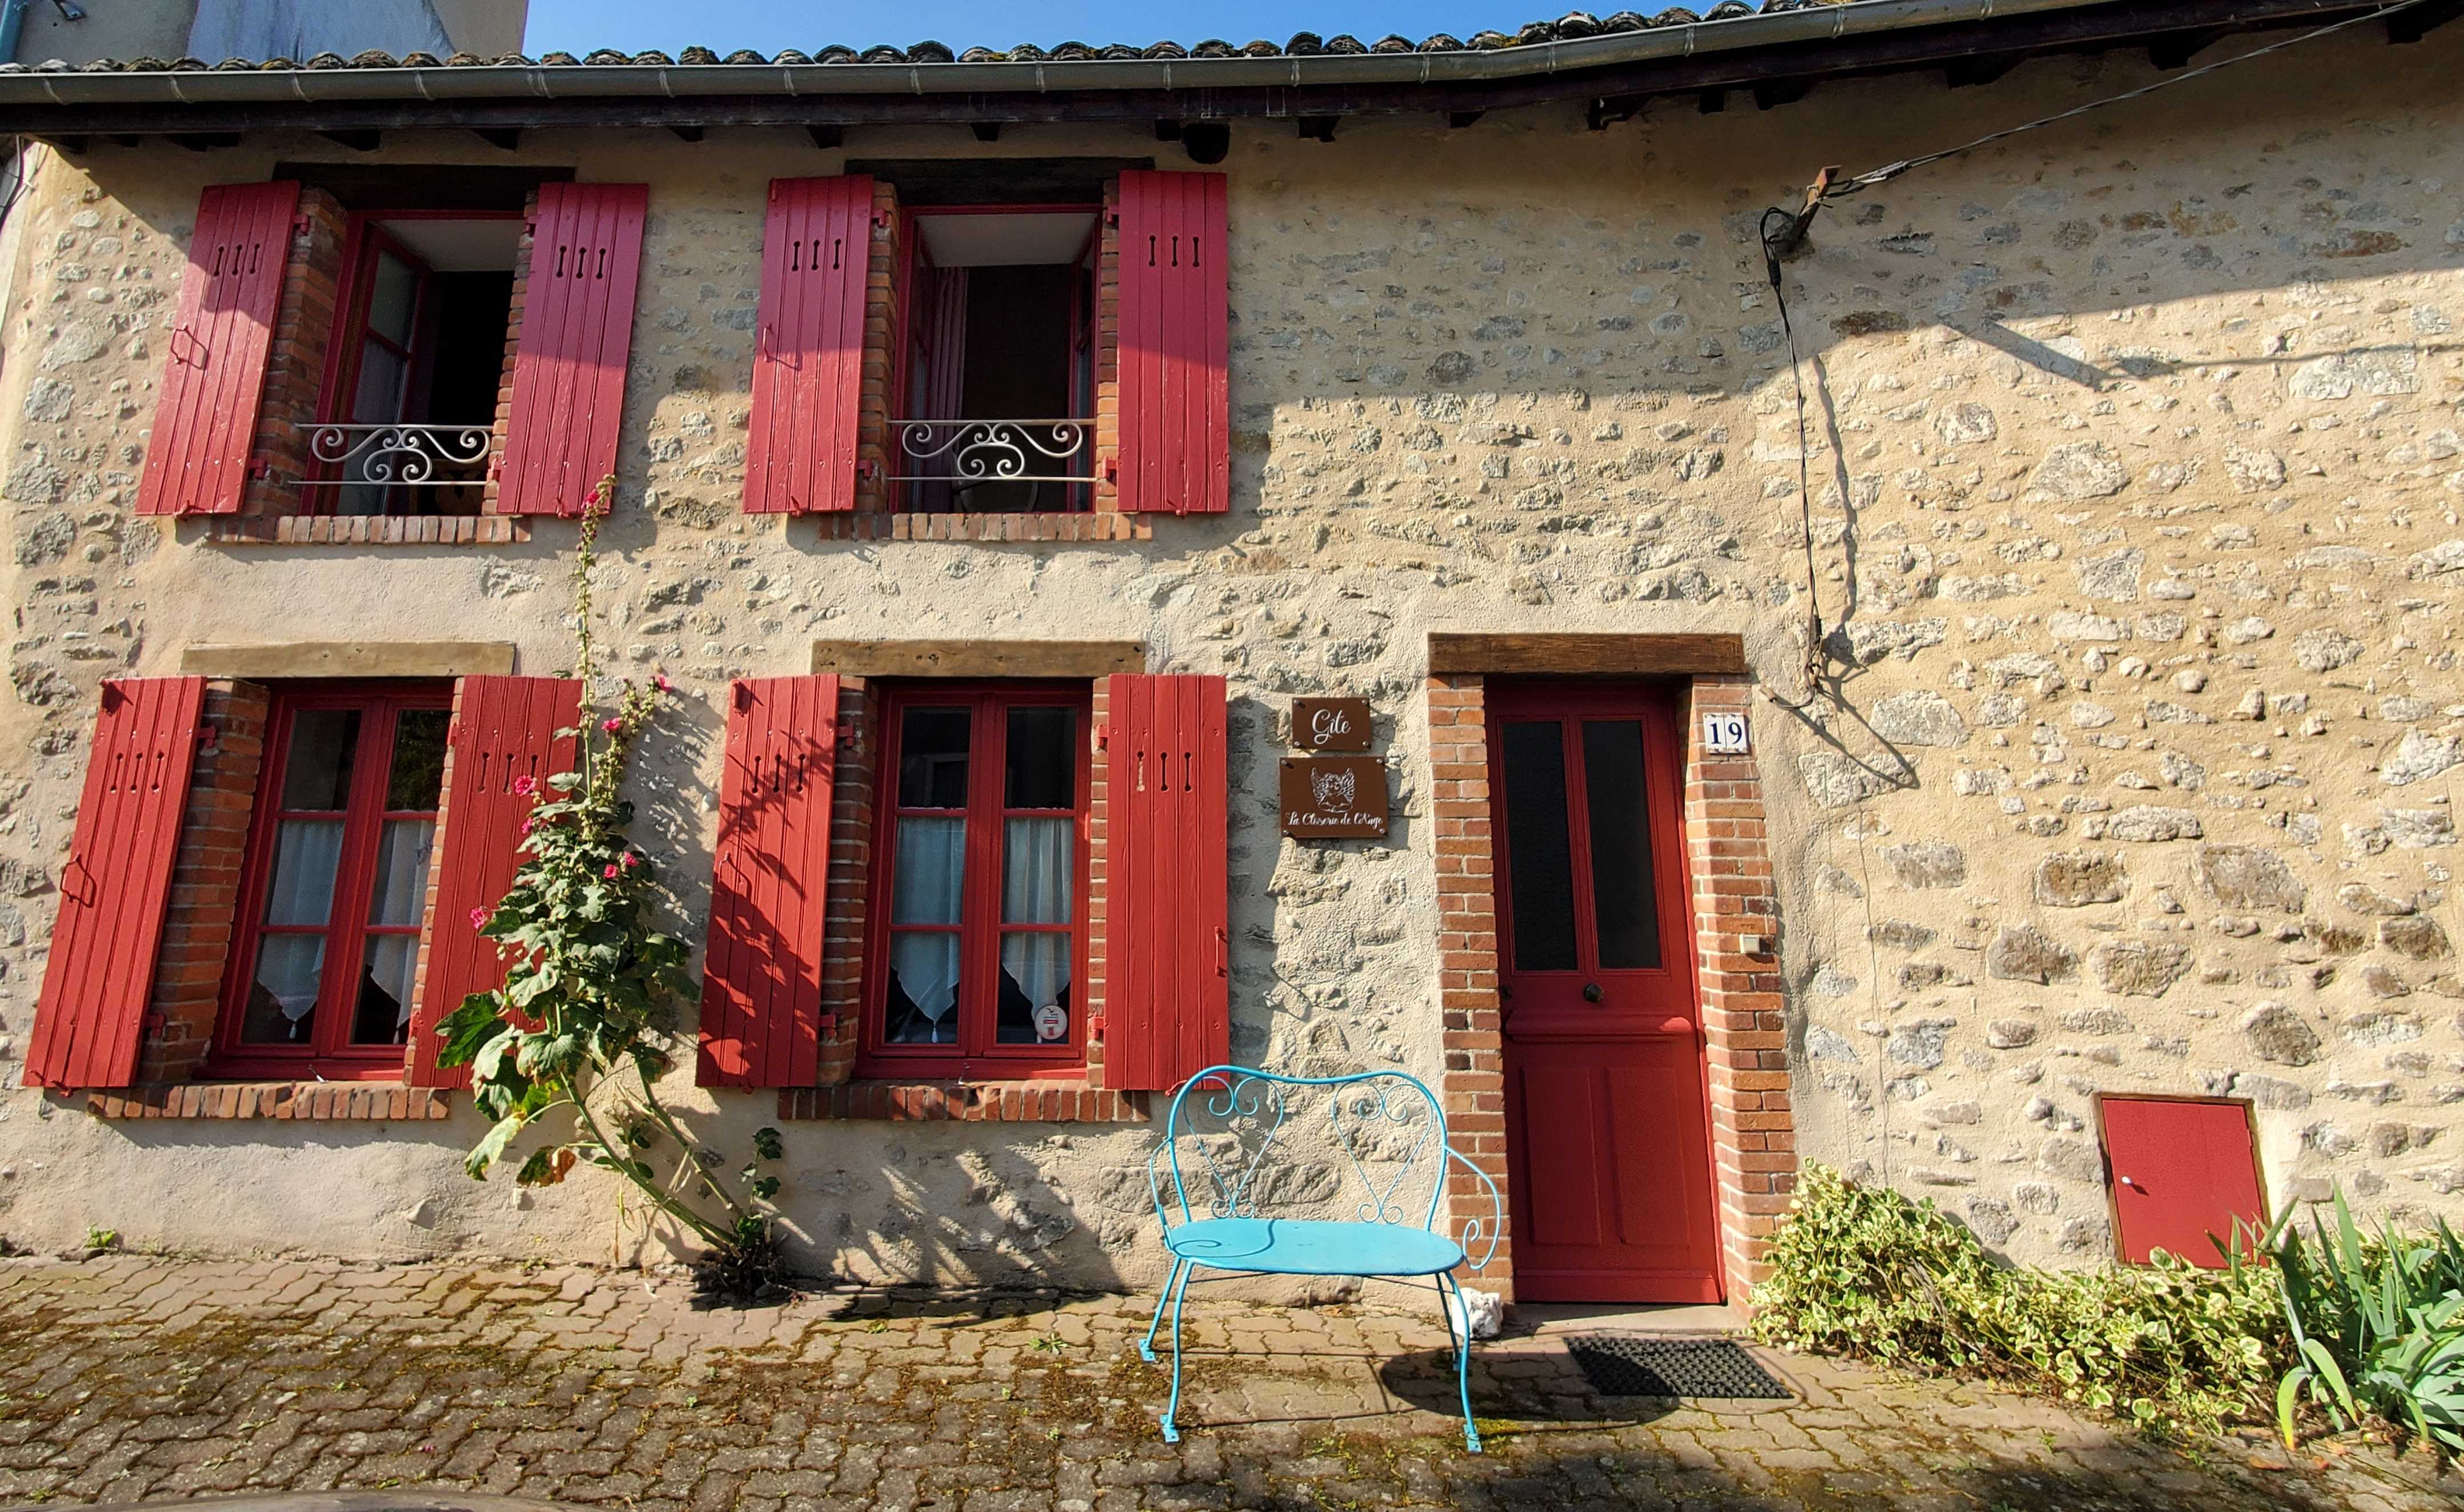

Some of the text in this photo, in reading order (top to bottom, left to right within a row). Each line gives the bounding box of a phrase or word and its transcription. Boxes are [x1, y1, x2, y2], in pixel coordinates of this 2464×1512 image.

[1312, 709, 1351, 745] Gîte
[1710, 722, 1743, 745] 19
[1287, 811, 1300, 826] La
[1302, 811, 1339, 826] Closerie
[1340, 812, 1351, 825] de
